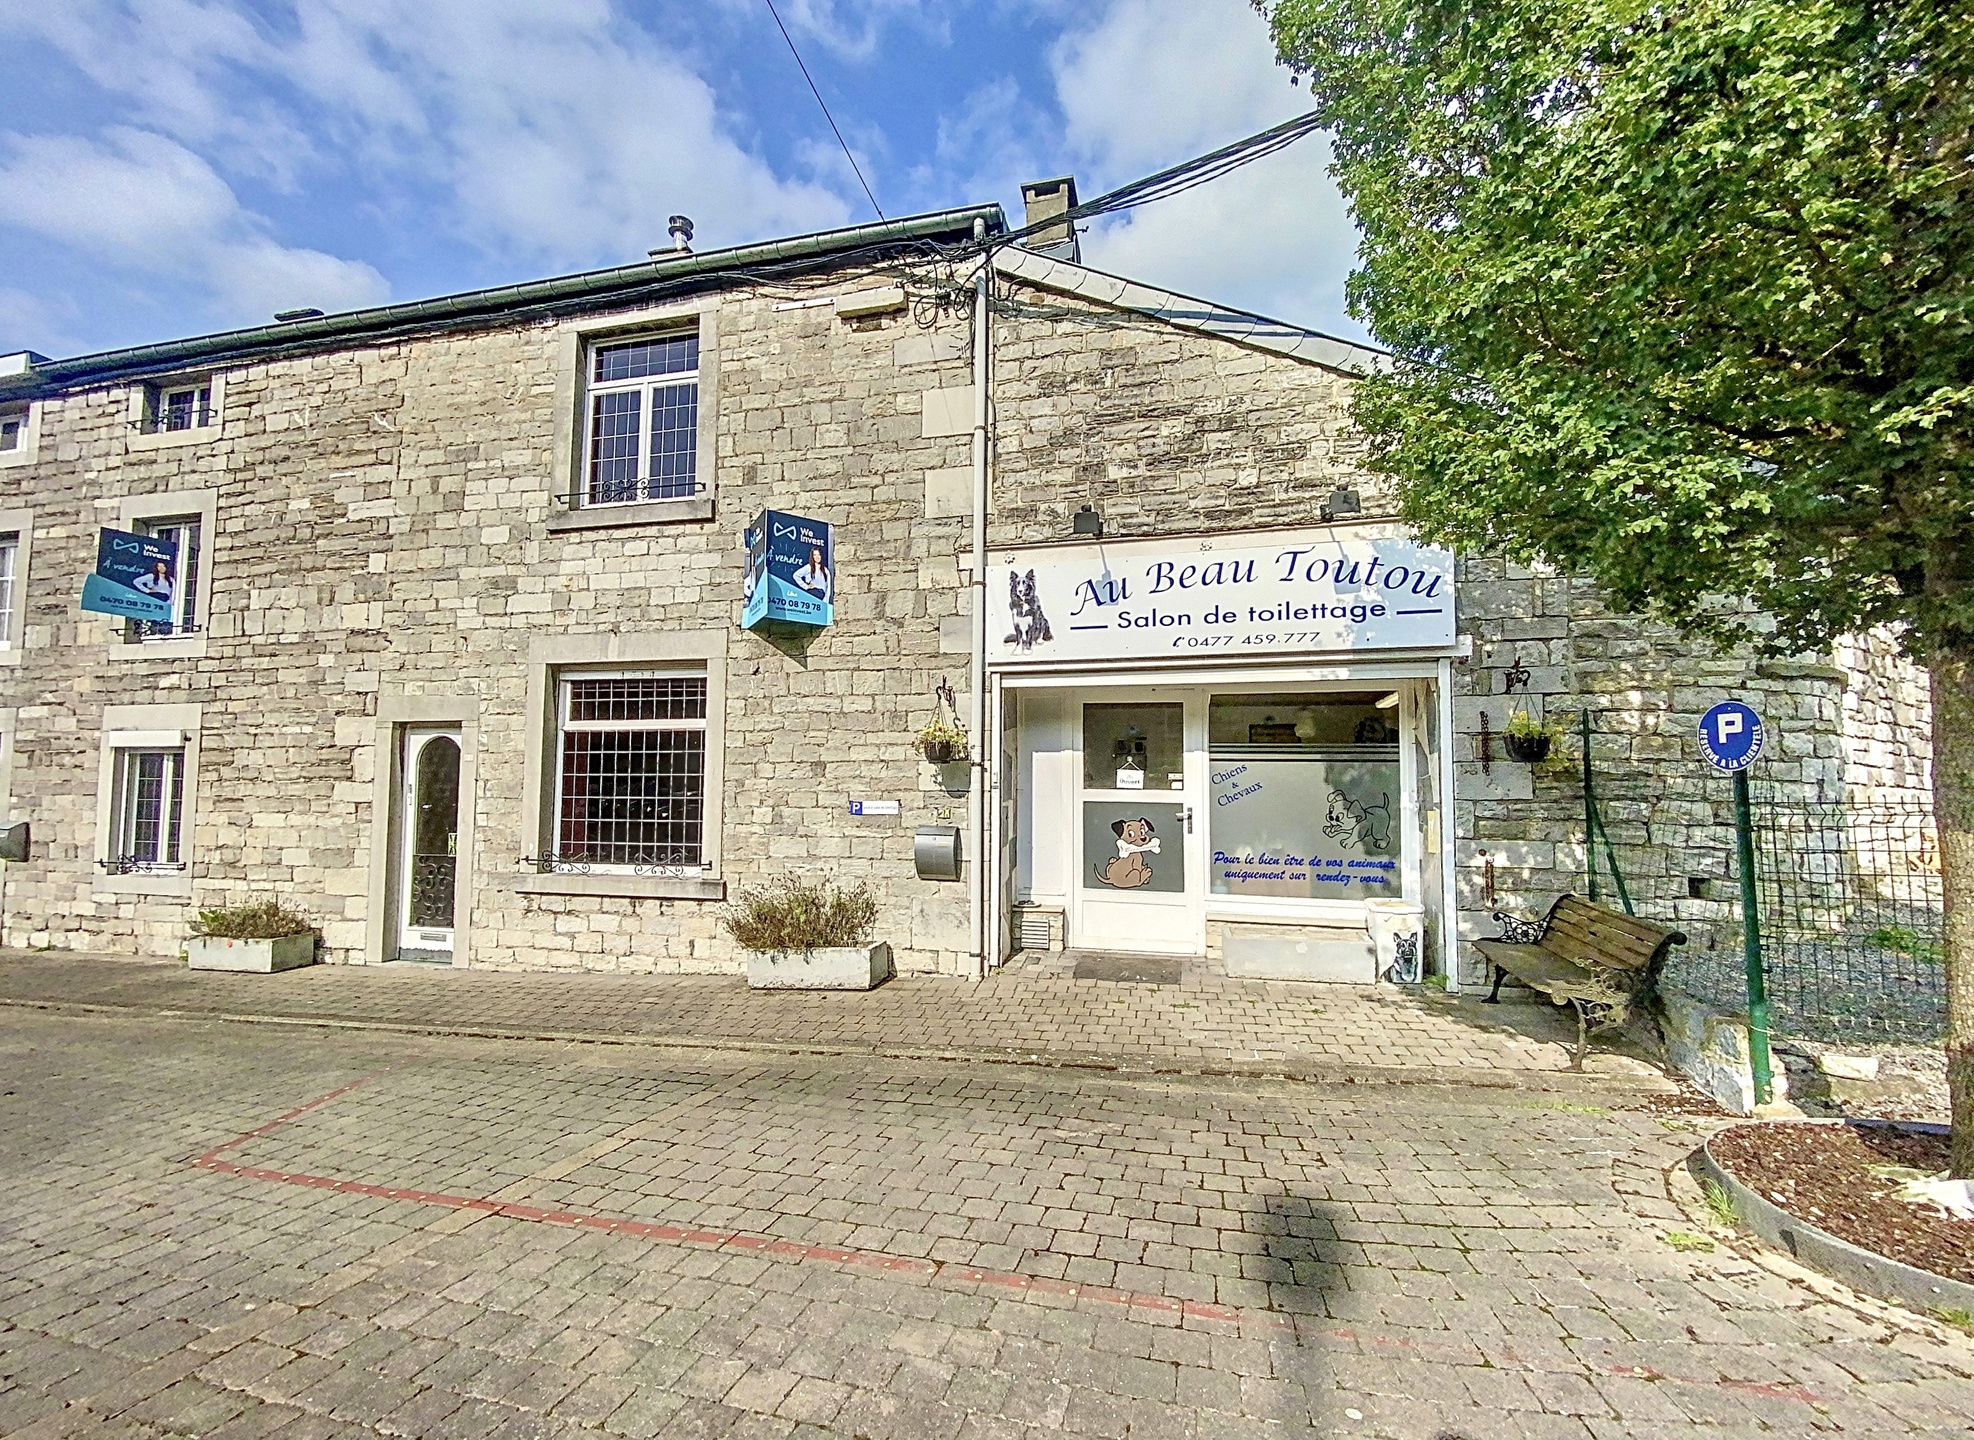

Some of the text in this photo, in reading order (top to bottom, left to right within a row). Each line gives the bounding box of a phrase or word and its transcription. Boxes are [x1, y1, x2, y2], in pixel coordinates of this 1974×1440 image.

[800, 527, 814, 537] We
[800, 534, 825, 546] Invest
[143, 543, 159, 553] We
[143, 550, 171, 560] Invest
[775, 554, 803, 566] vendre
[113, 564, 145, 574] vendre
[1070, 545, 1442, 616] Au Beau Toutou
[100, 595, 124, 605] 0470
[788, 599, 799, 608] 08
[800, 601, 810, 610] 79
[811, 603, 822, 612] 78
[1117, 601, 1386, 629] Salon de toilettage
[1187, 632, 1321, 648] 0477 459.777
[1717, 712, 1743, 744] P
[1728, 759, 1739, 768] LA
[1211, 764, 1248, 785] Chiens
[1231, 781, 1240, 789] &
[1217, 781, 1264, 807] Chevaux
[852, 802, 861, 814] P
[1213, 851, 1396, 869] Pour le bien être de vos animaux
[1224, 869, 1286, 883] uniquement
[1288, 872, 1307, 880] sur
